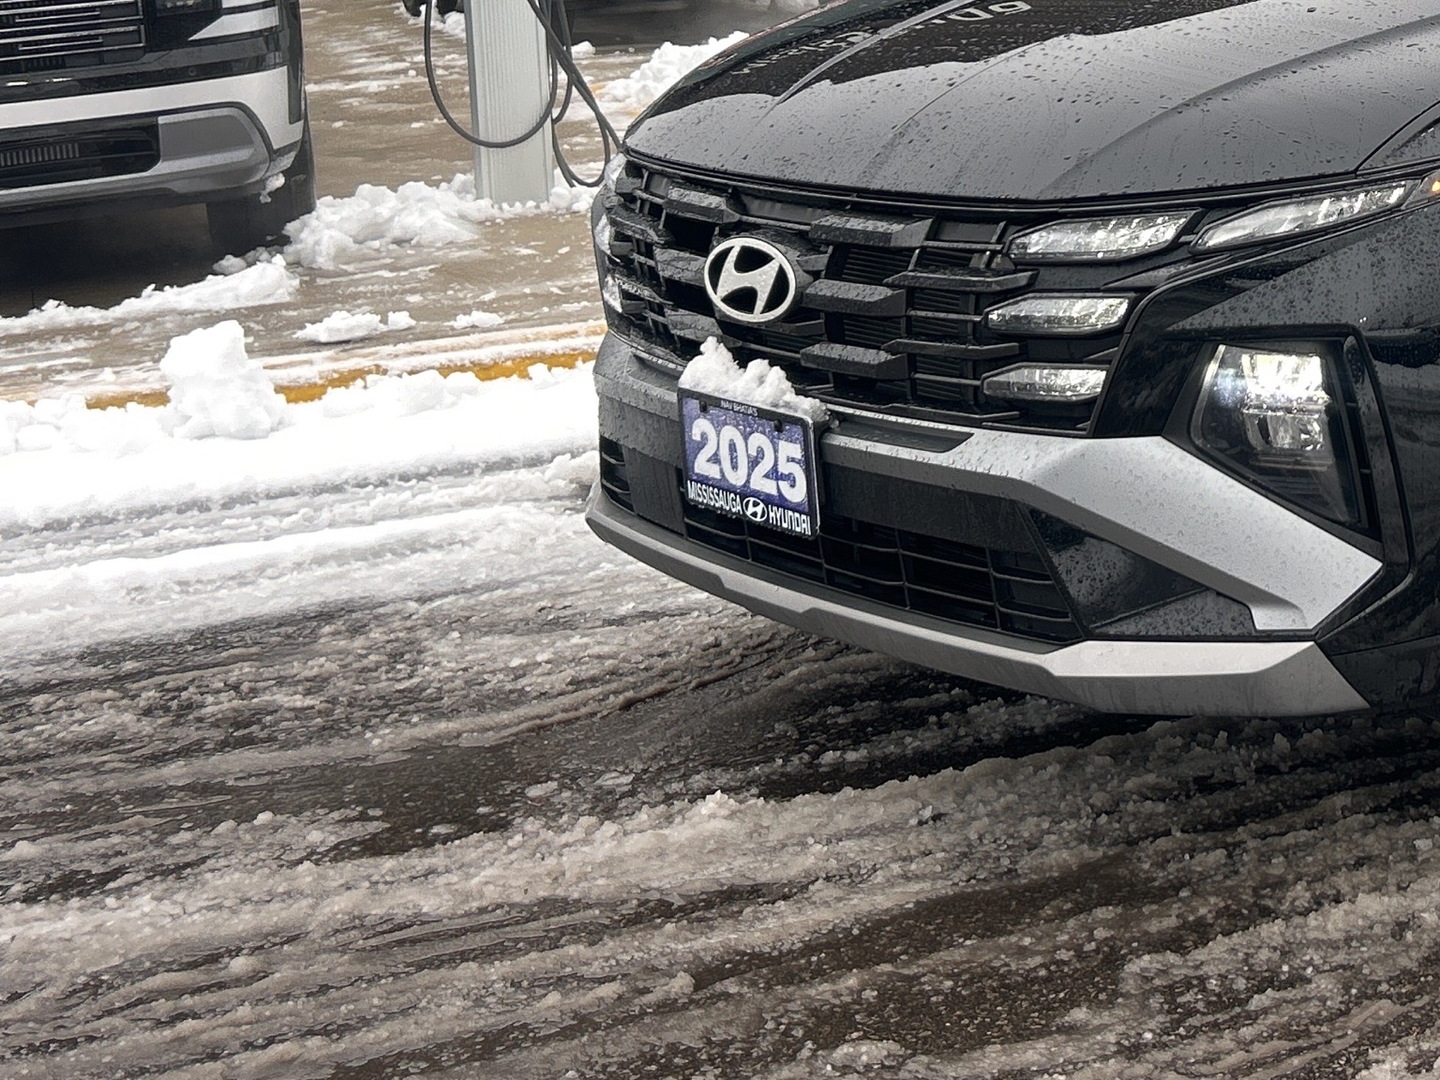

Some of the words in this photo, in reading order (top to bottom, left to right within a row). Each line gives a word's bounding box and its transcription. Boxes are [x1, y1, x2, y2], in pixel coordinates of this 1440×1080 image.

[691, 418, 808, 504] 2025
[687, 479, 743, 516] MISSISSAUGA
[768, 504, 812, 536] HYUNDAI
